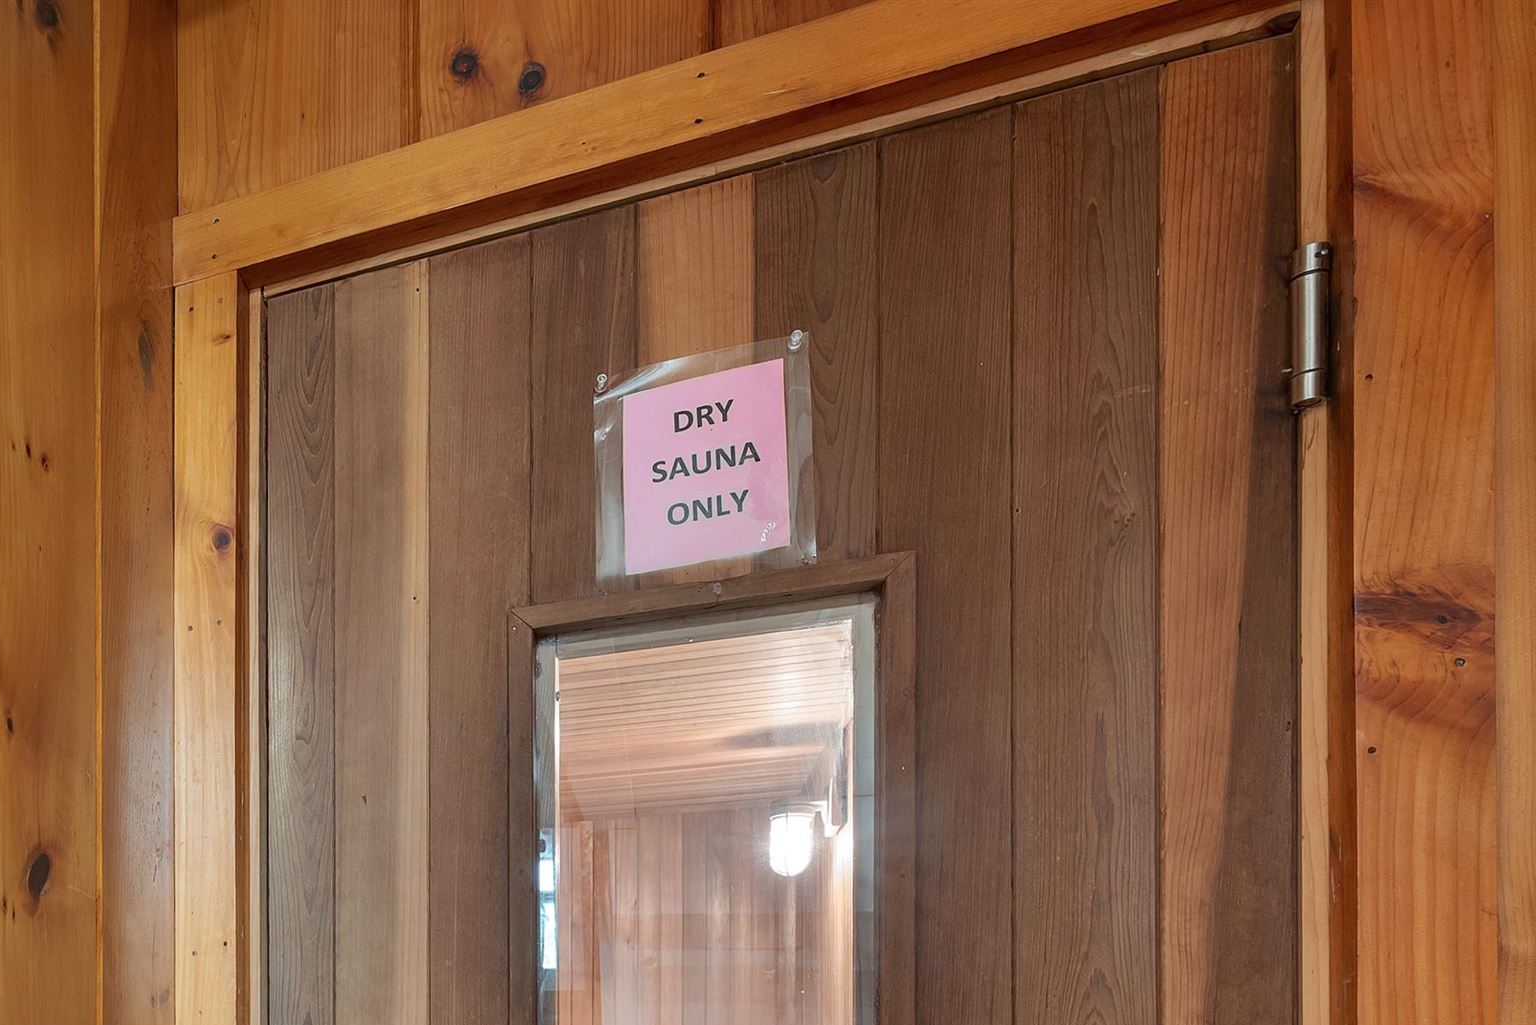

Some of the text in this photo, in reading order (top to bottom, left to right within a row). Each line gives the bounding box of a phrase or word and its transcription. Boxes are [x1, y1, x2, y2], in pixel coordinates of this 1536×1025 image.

[673, 398, 734, 433] DRY
[652, 441, 761, 483] SAUNA
[667, 489, 749, 526] ONLY
